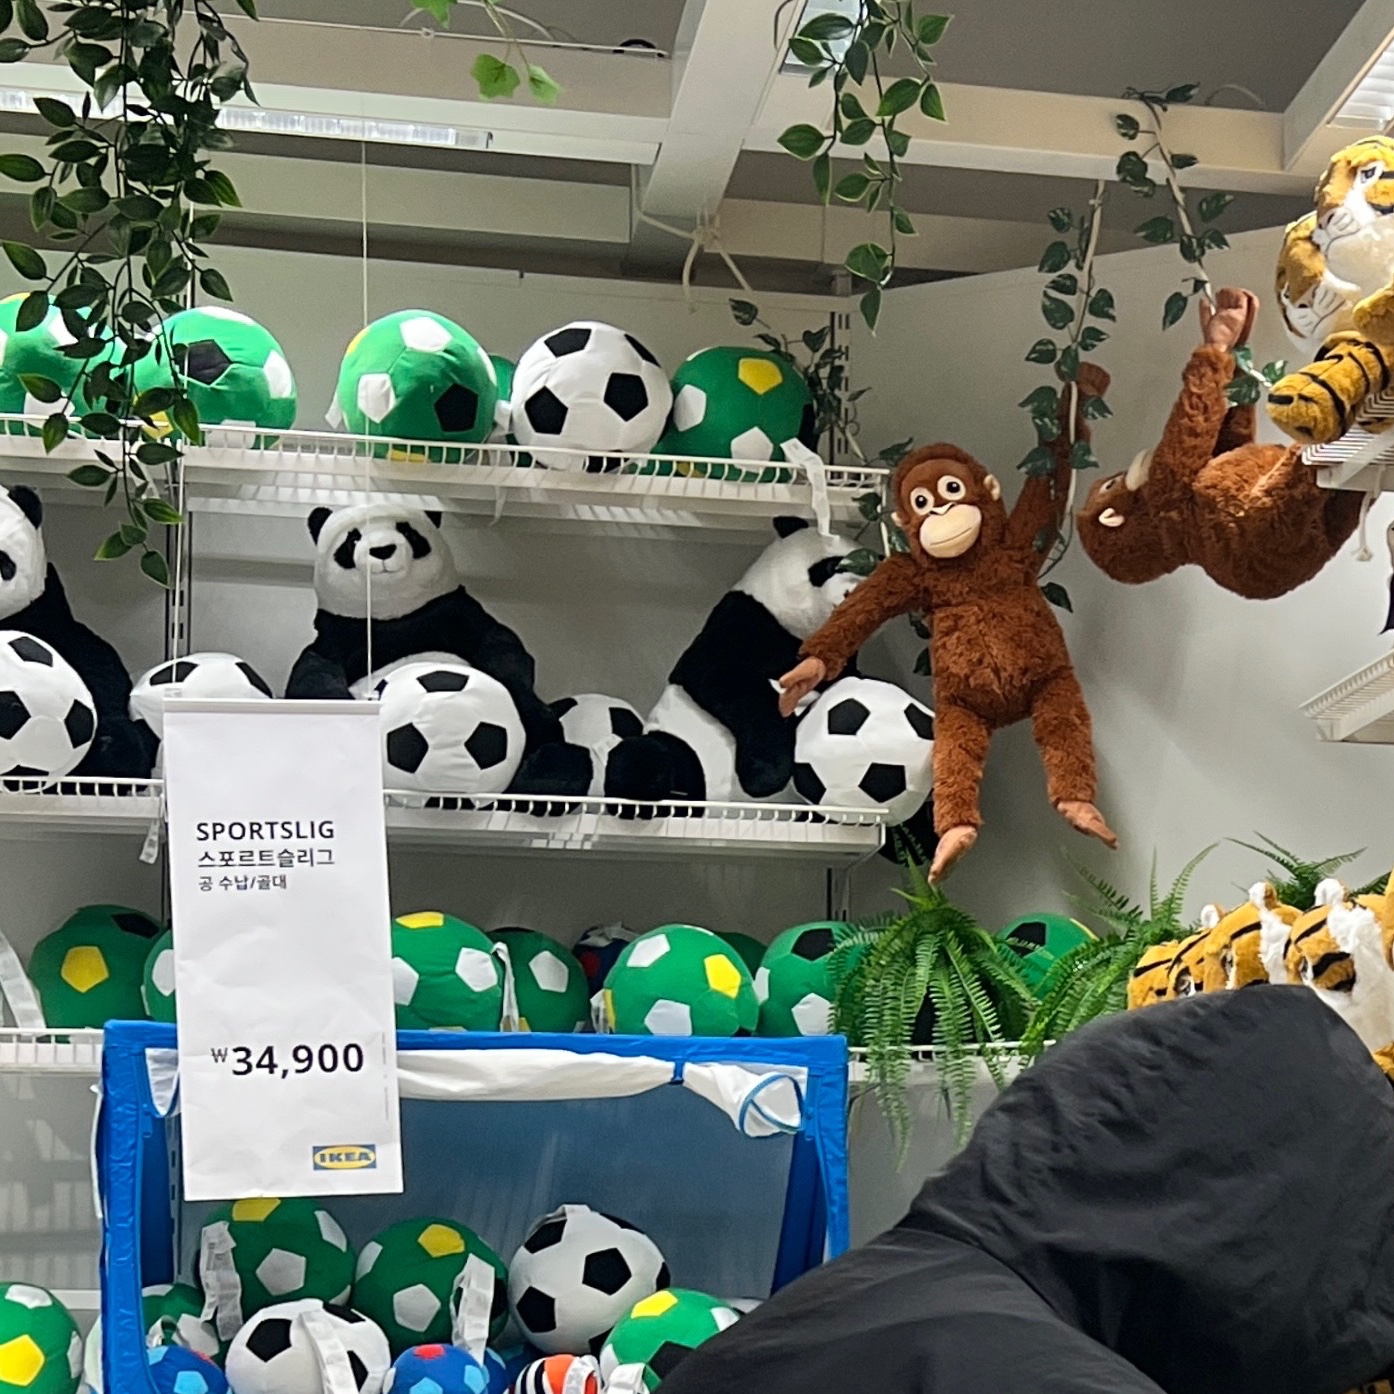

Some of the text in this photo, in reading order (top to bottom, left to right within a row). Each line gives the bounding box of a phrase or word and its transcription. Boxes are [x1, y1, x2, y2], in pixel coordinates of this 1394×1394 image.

[196, 820, 335, 842] SPORTSLIG
[197, 847, 335, 868] 스포르트슬리그
[198, 874, 287, 893] 공 수납/골대
[318, 1151, 372, 1164] IKEA
